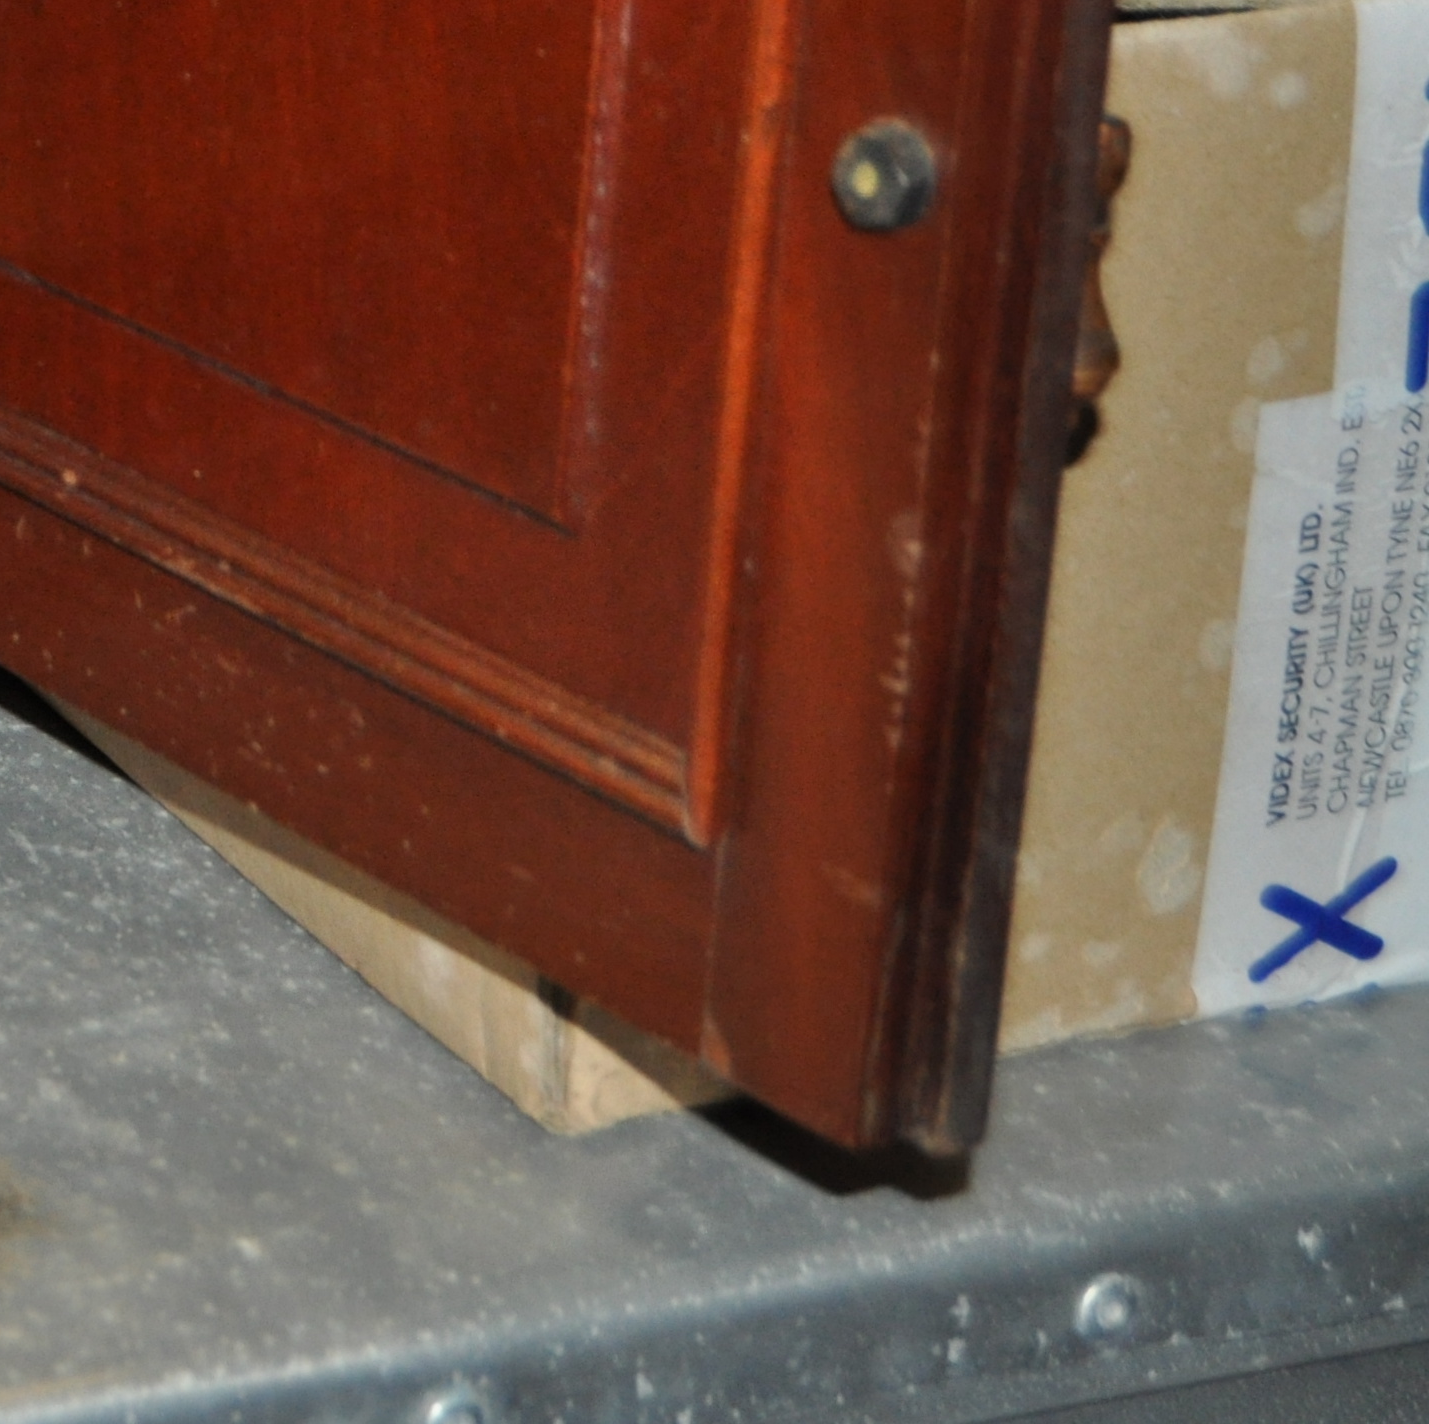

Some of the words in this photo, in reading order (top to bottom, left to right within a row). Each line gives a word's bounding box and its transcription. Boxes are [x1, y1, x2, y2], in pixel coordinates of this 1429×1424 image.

[1335, 439, 1361, 494] IND.
[1394, 440, 1420, 493] NE6
[1299, 503, 1325, 554] LTD.
[1386, 497, 1414, 564] TYNE
[1292, 562, 1320, 616] (UK)
[1313, 500, 1353, 689] CHILLINGHAM
[1377, 570, 1406, 649] UPON
[1278, 627, 1309, 744] SECURITY
[1308, 696, 1332, 744] 4-7,
[1326, 673, 1364, 815] CHAPMAN
[1345, 585, 1374, 669] STREET
[1356, 654, 1395, 809] NEWCASTLE
[1266, 749, 1295, 827] VIDEX
[1297, 751, 1325, 820] UNITS
